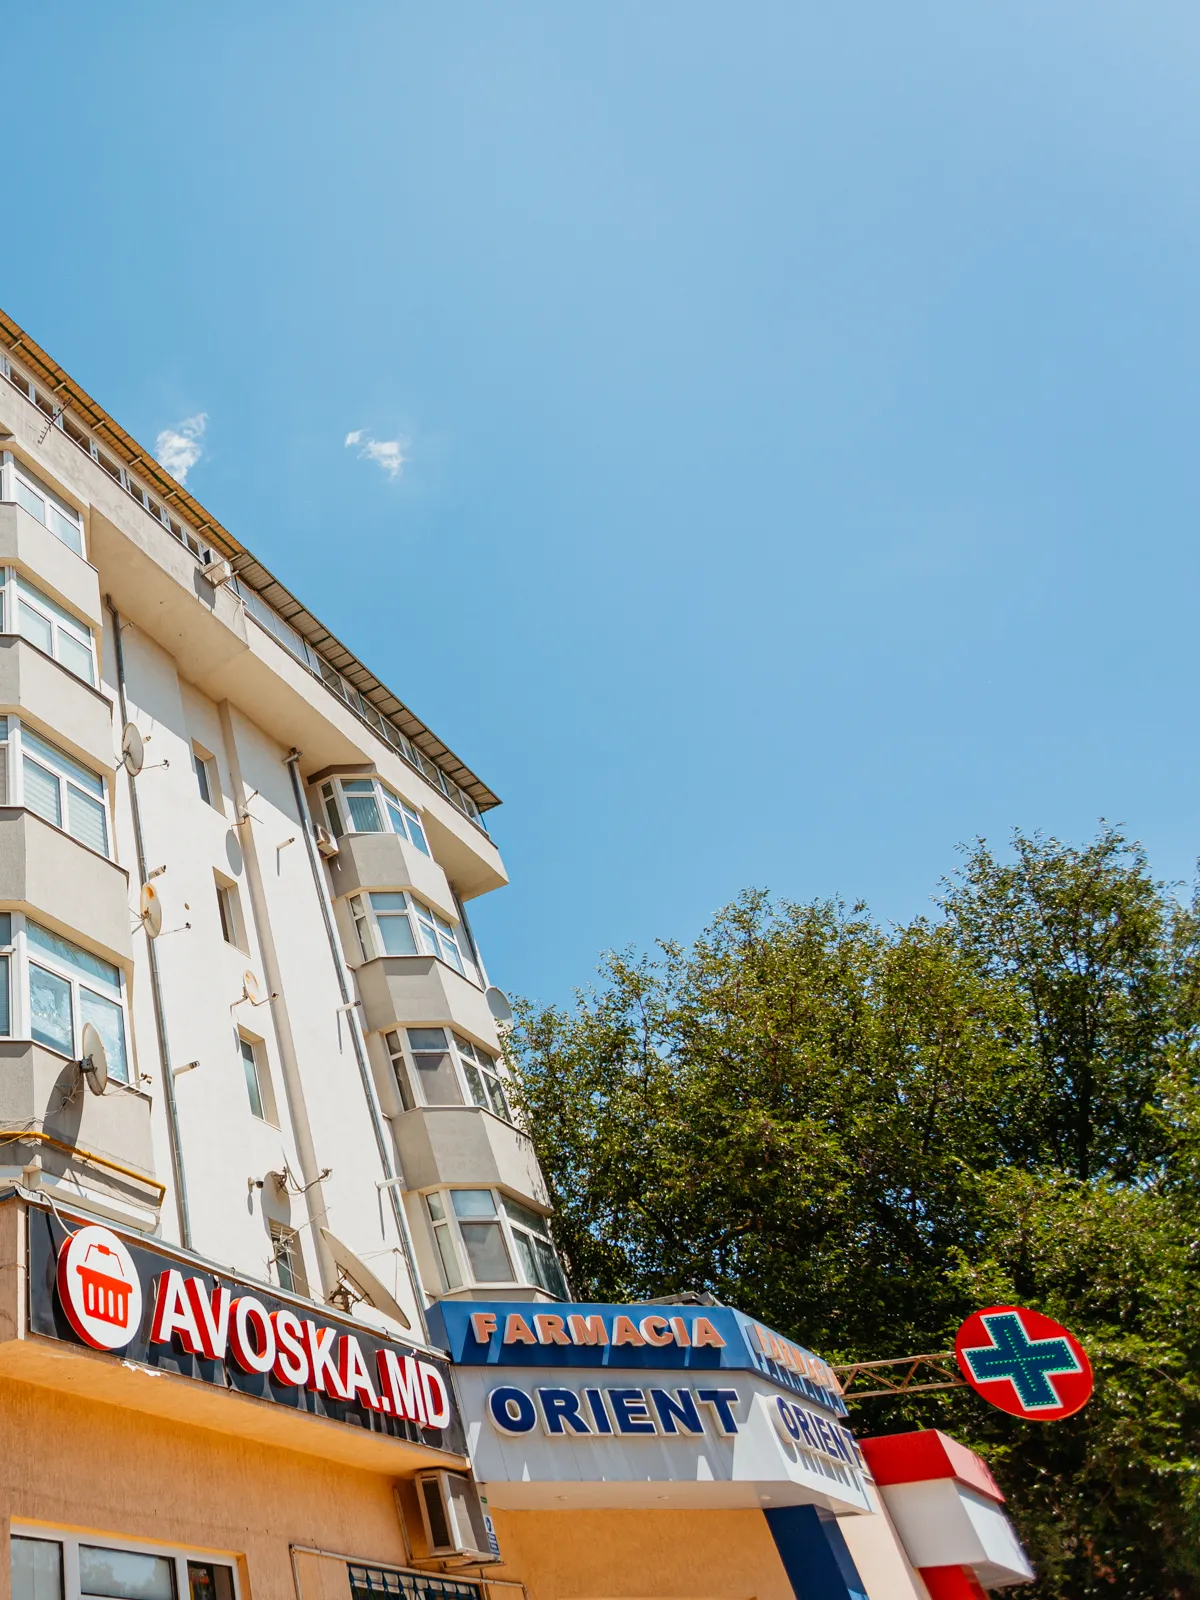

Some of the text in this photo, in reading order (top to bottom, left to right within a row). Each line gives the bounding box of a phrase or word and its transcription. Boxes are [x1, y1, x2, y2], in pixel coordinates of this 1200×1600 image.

[150, 1268, 450, 1430] AVOSKA.MD
[471, 1312, 727, 1348] FARMACIA
[487, 1385, 740, 1439] ORIENT
[773, 1395, 864, 1471] ORIENT
